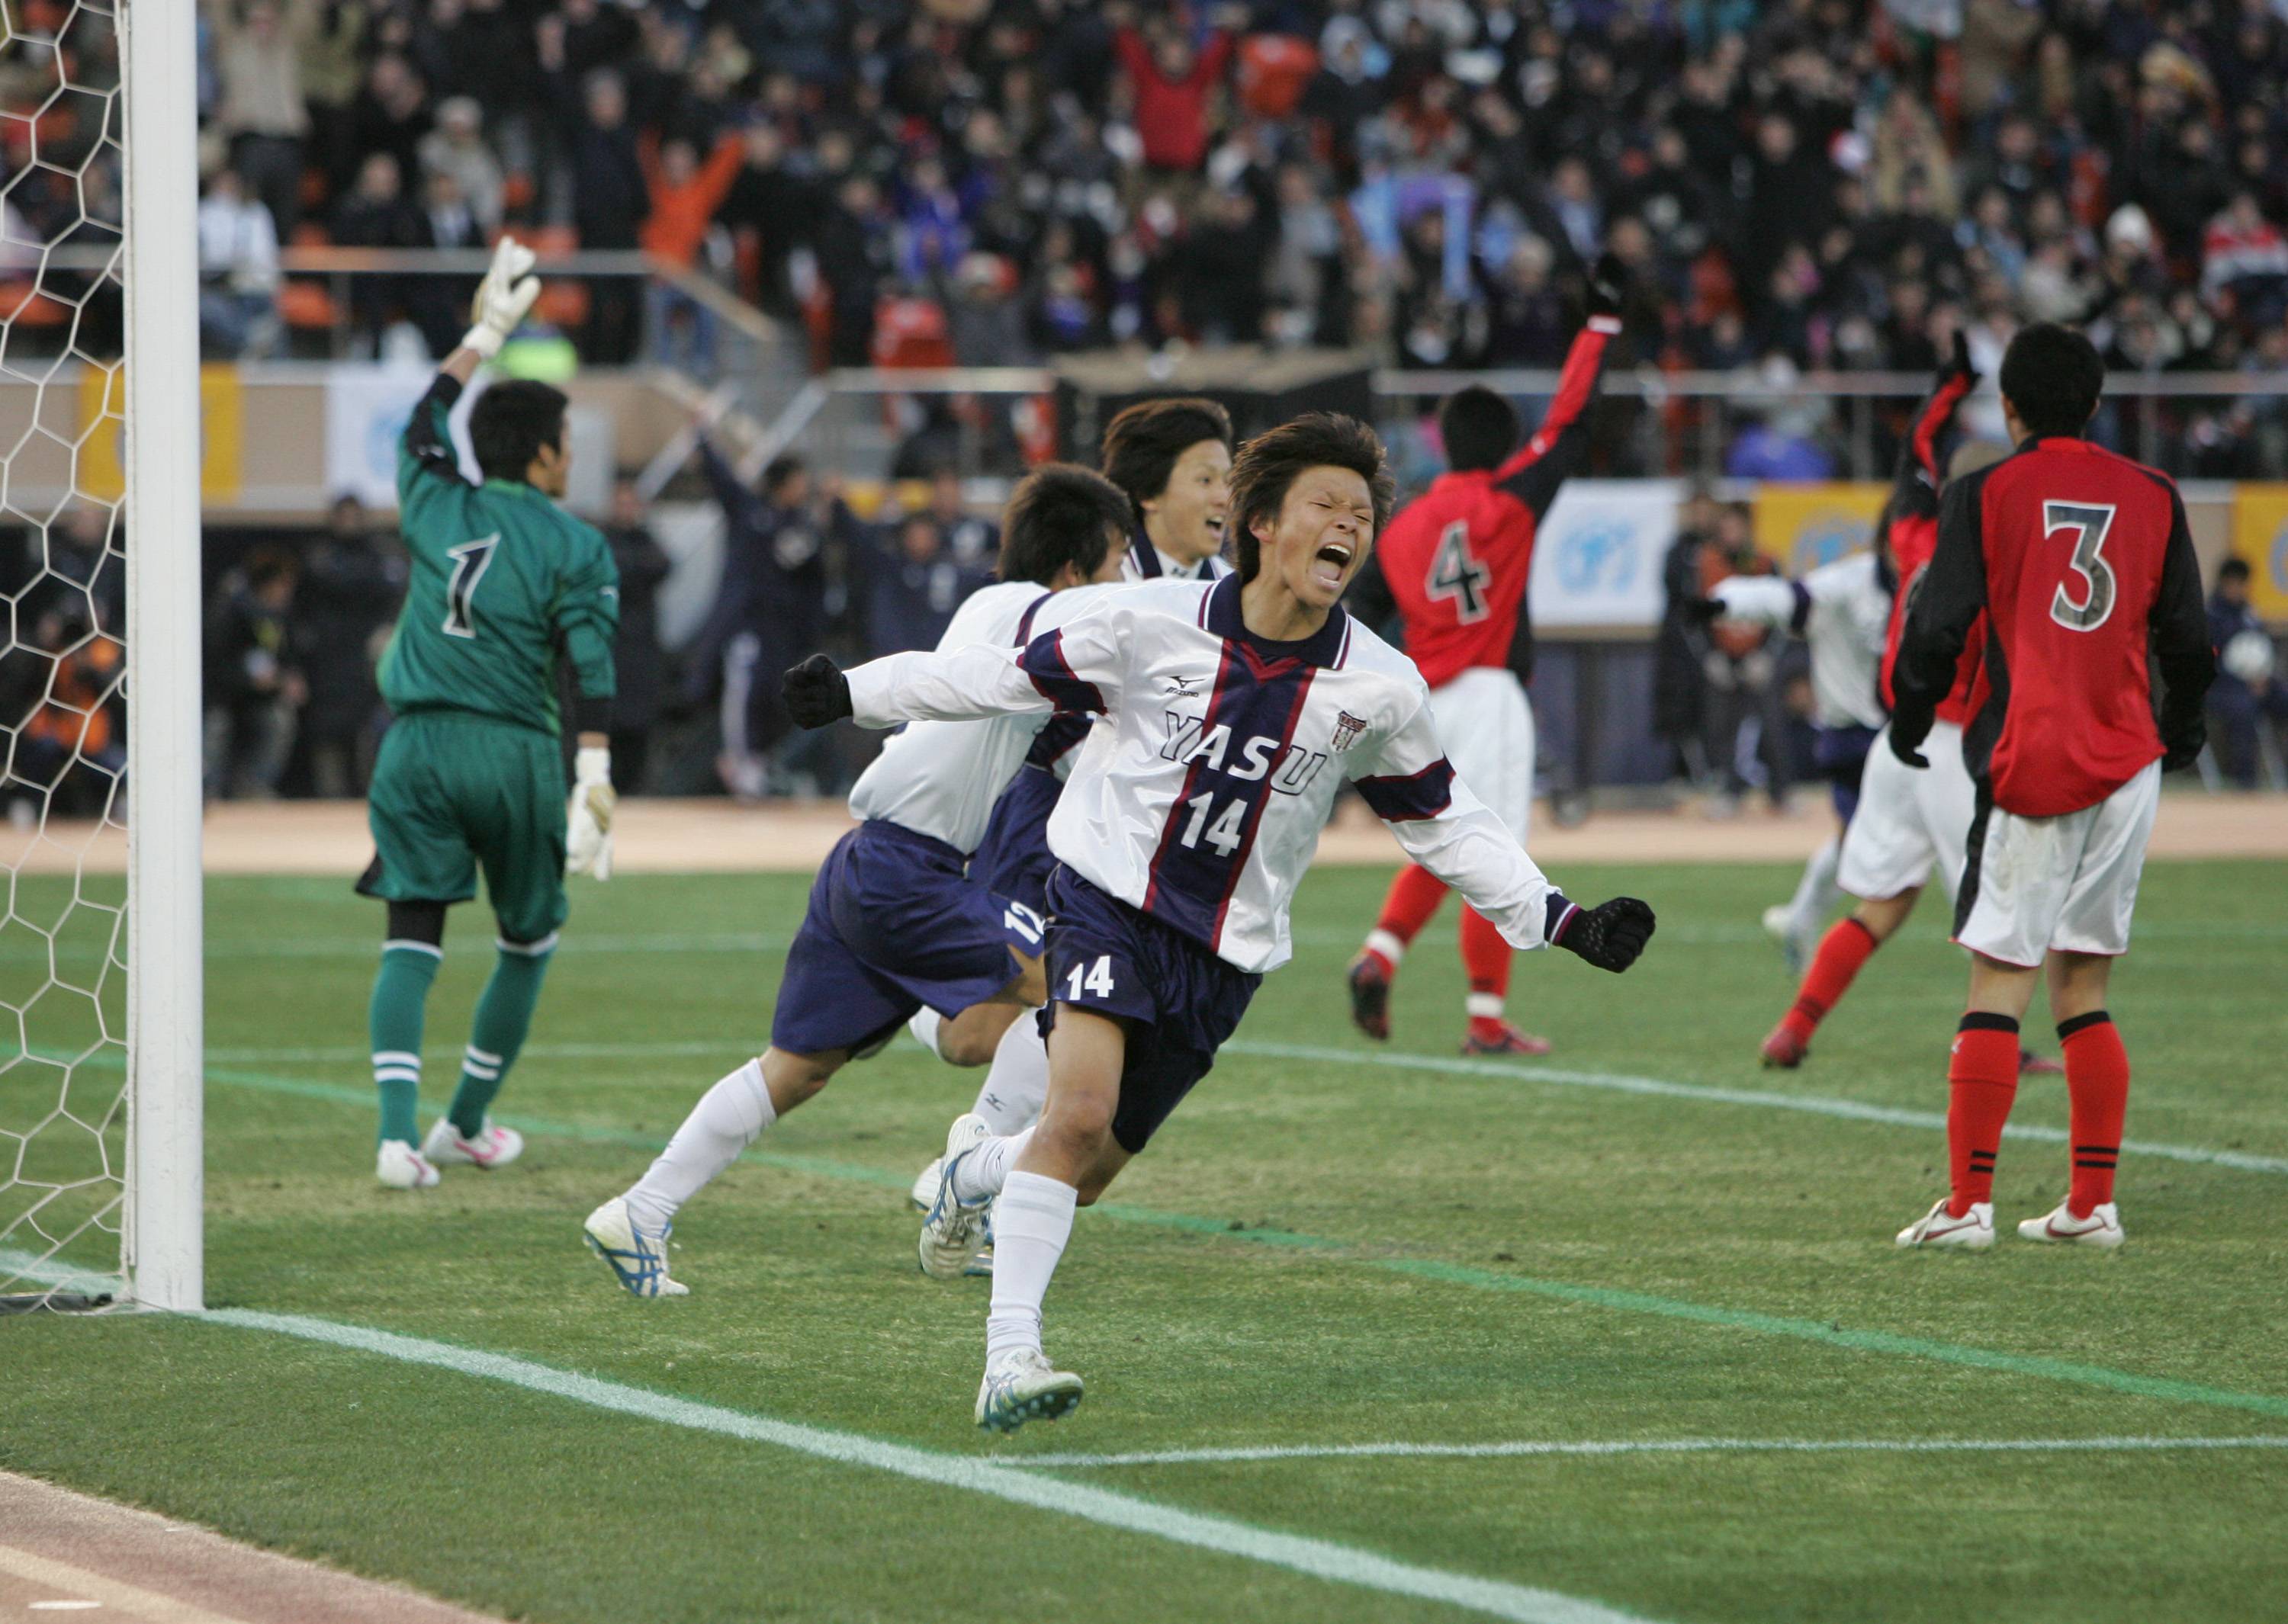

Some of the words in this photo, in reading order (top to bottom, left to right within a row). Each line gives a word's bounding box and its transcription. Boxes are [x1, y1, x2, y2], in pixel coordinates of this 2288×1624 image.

[442, 531, 501, 639] 1
[1425, 518, 1491, 625] 4
[2042, 500, 2116, 631] 3
[1160, 710, 1327, 796] YASU
[1181, 791, 1248, 858] 14
[1004, 901, 1046, 945] 12
[1066, 955, 1114, 1001] 14
